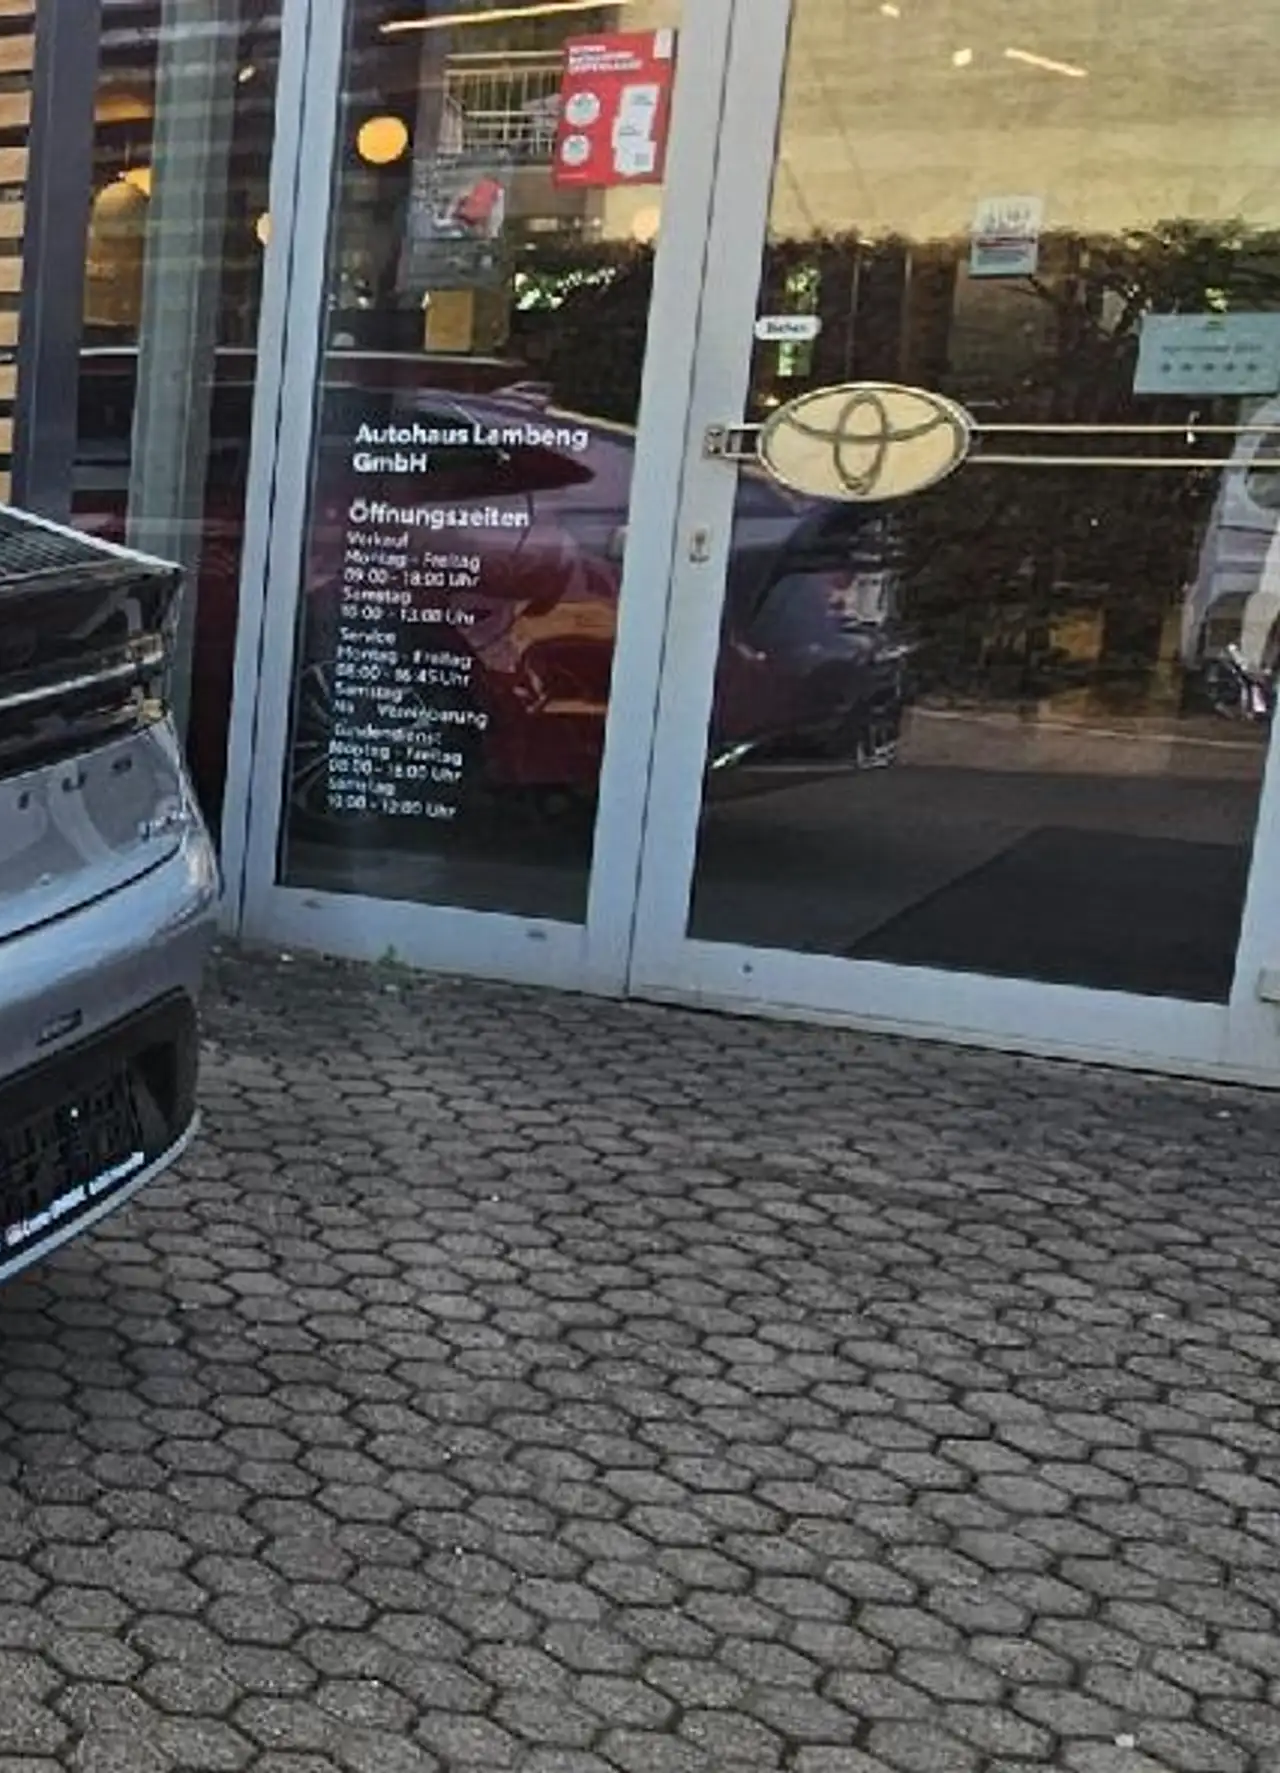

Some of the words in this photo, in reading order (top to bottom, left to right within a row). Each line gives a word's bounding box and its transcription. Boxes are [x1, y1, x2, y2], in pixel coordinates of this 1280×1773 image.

[354, 422, 469, 445] Autohaus
[472, 422, 590, 450] Lambeng
[352, 451, 428, 473] GmbH
[348, 499, 531, 530] Öffnungszeiten
[345, 530, 410, 548] Verkauf
[344, 549, 408, 569] Montag
[423, 552, 481, 573] Freitag
[448, 571, 481, 588] Uhr
[342, 584, 412, 607] Samstag
[445, 608, 476, 626] Uhr
[339, 626, 398, 646] Service
[336, 644, 399, 666] Montag
[412, 650, 474, 671] Freitag
[440, 670, 471, 688] Uhr
[328, 739, 391, 761] Montag
[406, 746, 463, 767] Freitag
[430, 766, 463, 783] Uhr
[425, 802, 458, 819] Uhr
